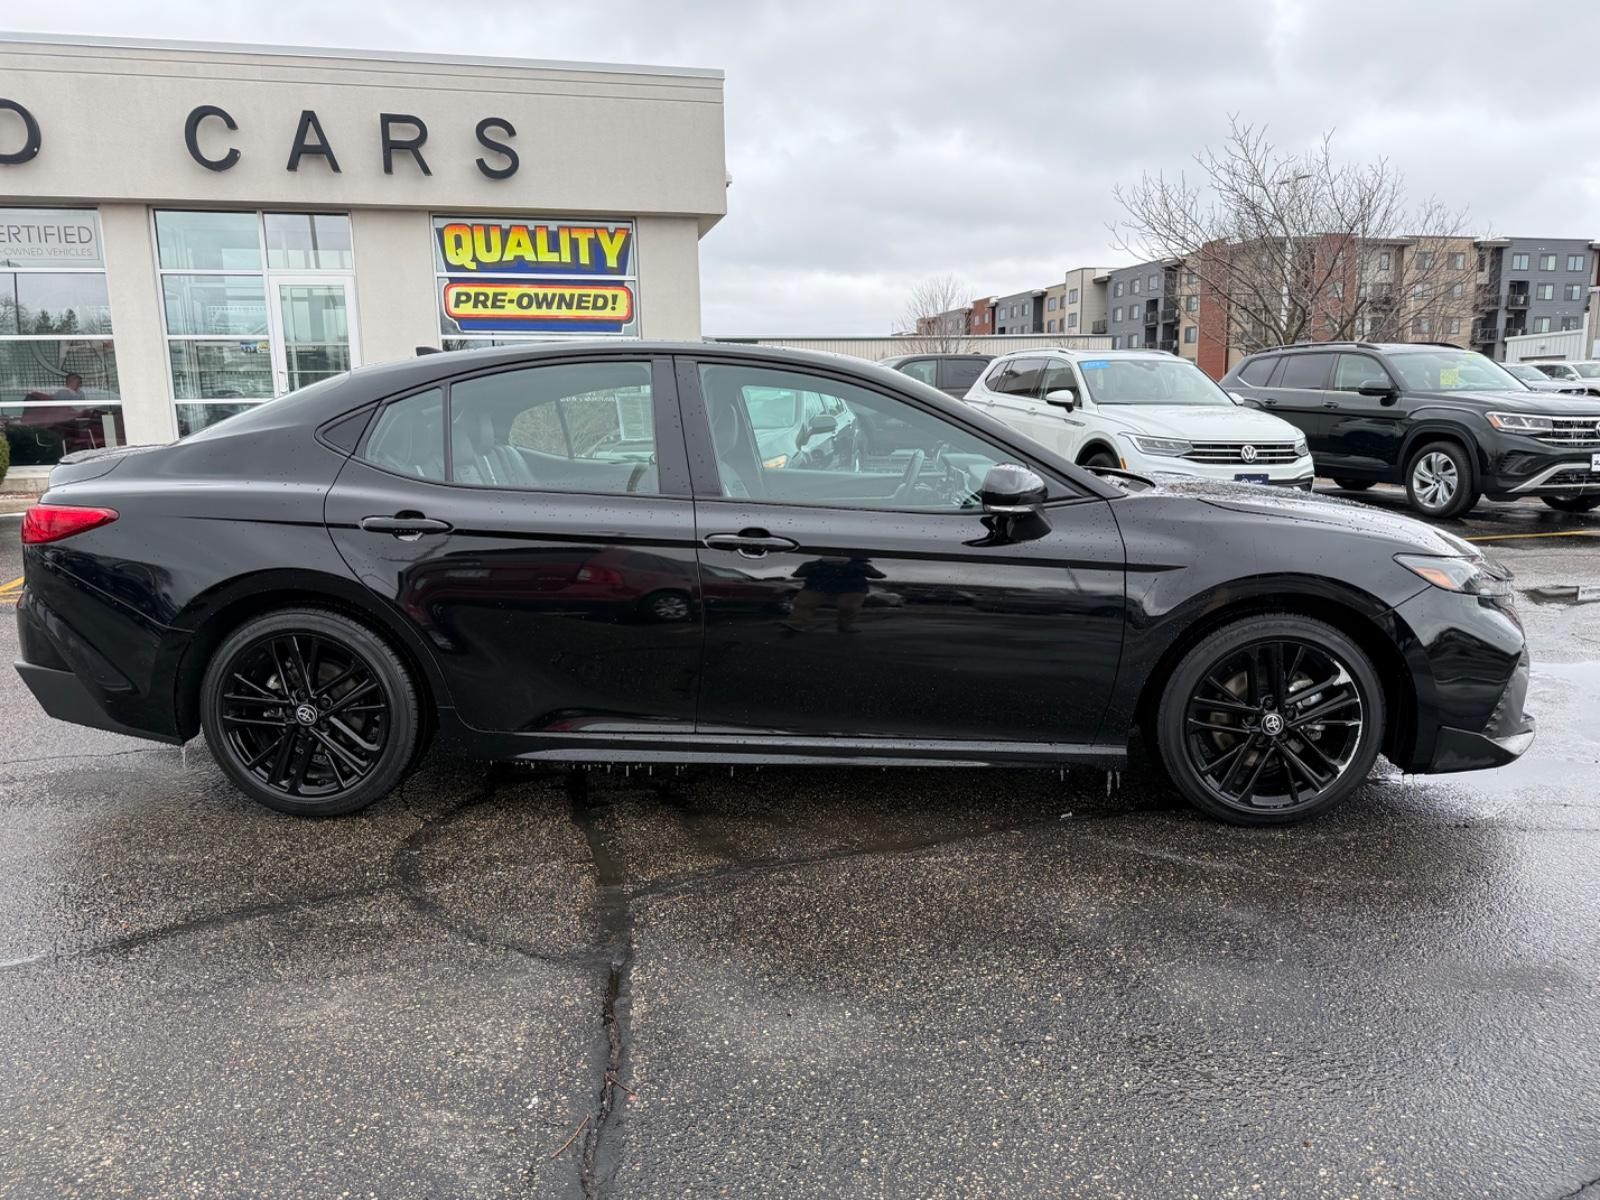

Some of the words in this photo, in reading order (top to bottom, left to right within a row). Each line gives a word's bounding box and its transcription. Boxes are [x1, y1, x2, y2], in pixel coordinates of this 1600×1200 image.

[184, 104, 520, 180] CARS
[46, 247, 94, 257] VEHICLES
[443, 223, 630, 270] QUALITY
[453, 291, 619, 311] PRE-OWNED!
